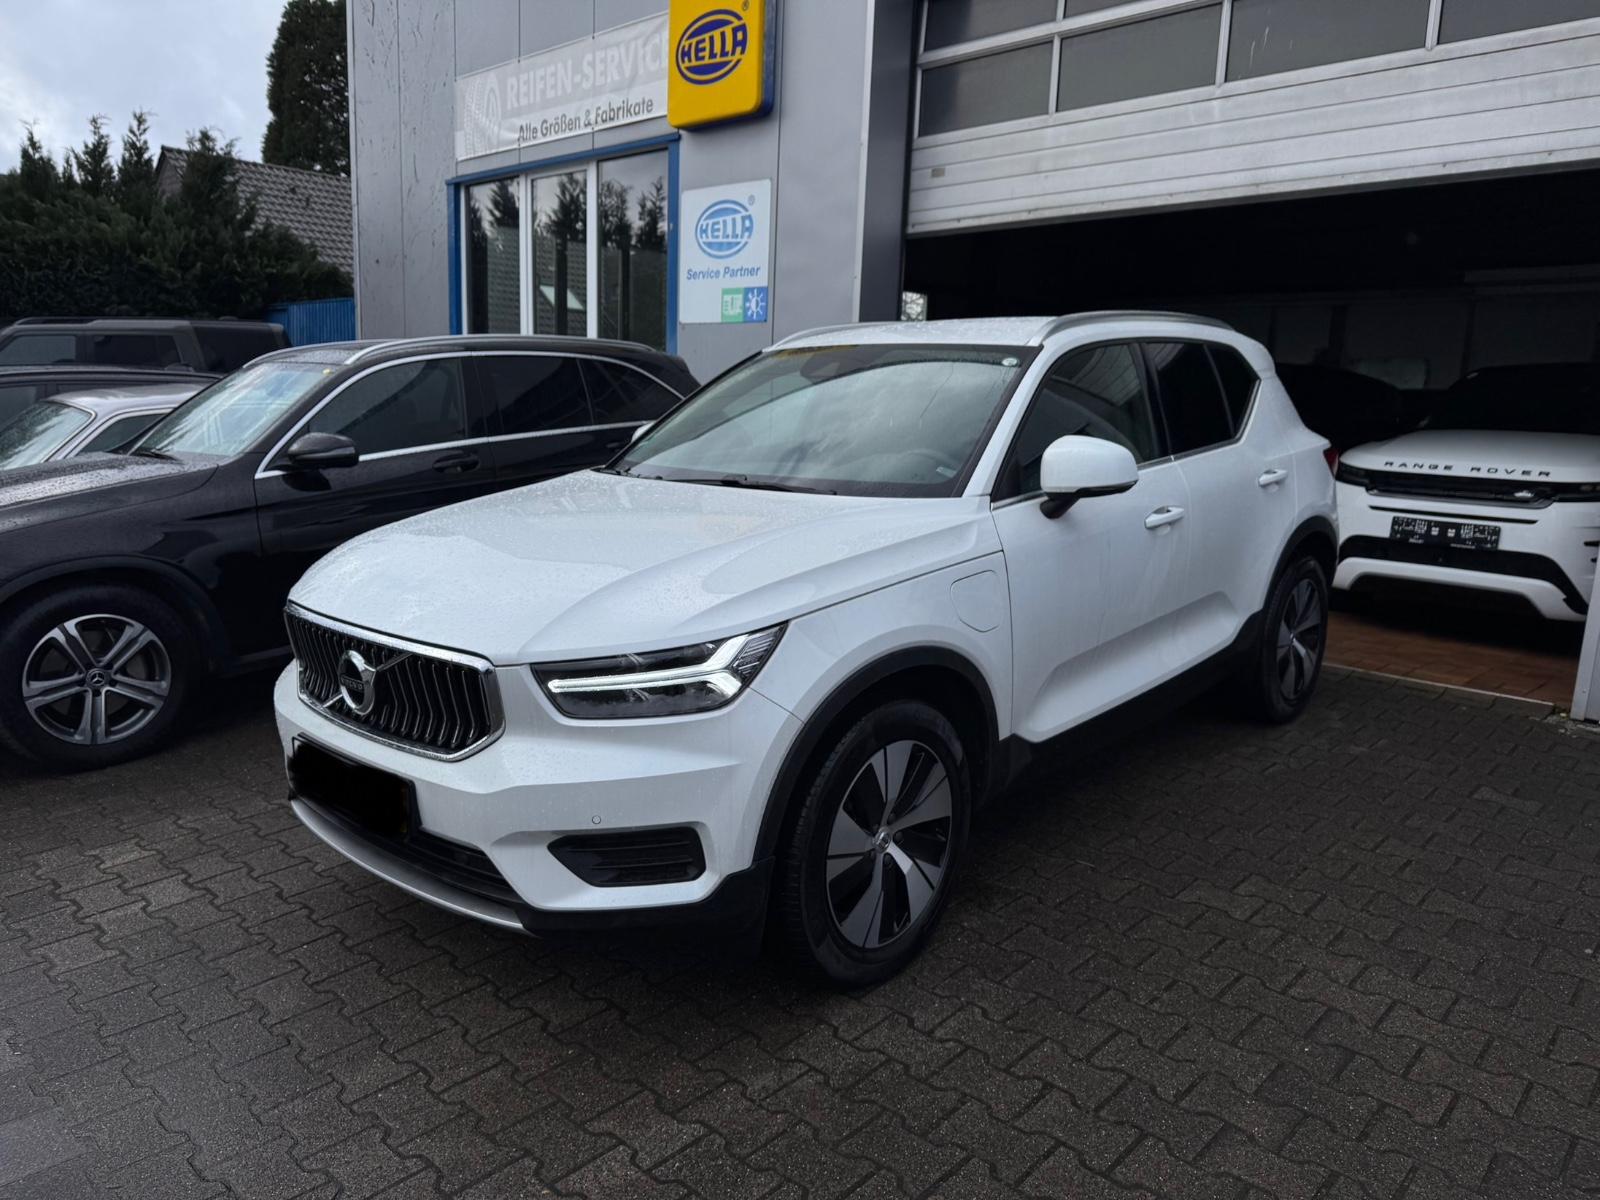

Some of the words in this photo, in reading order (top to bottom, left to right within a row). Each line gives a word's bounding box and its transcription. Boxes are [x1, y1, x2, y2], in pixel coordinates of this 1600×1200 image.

[681, 21, 747, 64] HELLA
[518, 124, 538, 142] Alle
[541, 114, 581, 137] Größen
[583, 109, 592, 127] &
[594, 97, 654, 125] Fabrikate
[699, 214, 754, 239] HELLA
[686, 267, 720, 280] Service
[722, 266, 760, 279] Partner
[1384, 461, 1453, 471] RANGE
[1470, 466, 1551, 477] ROVER
